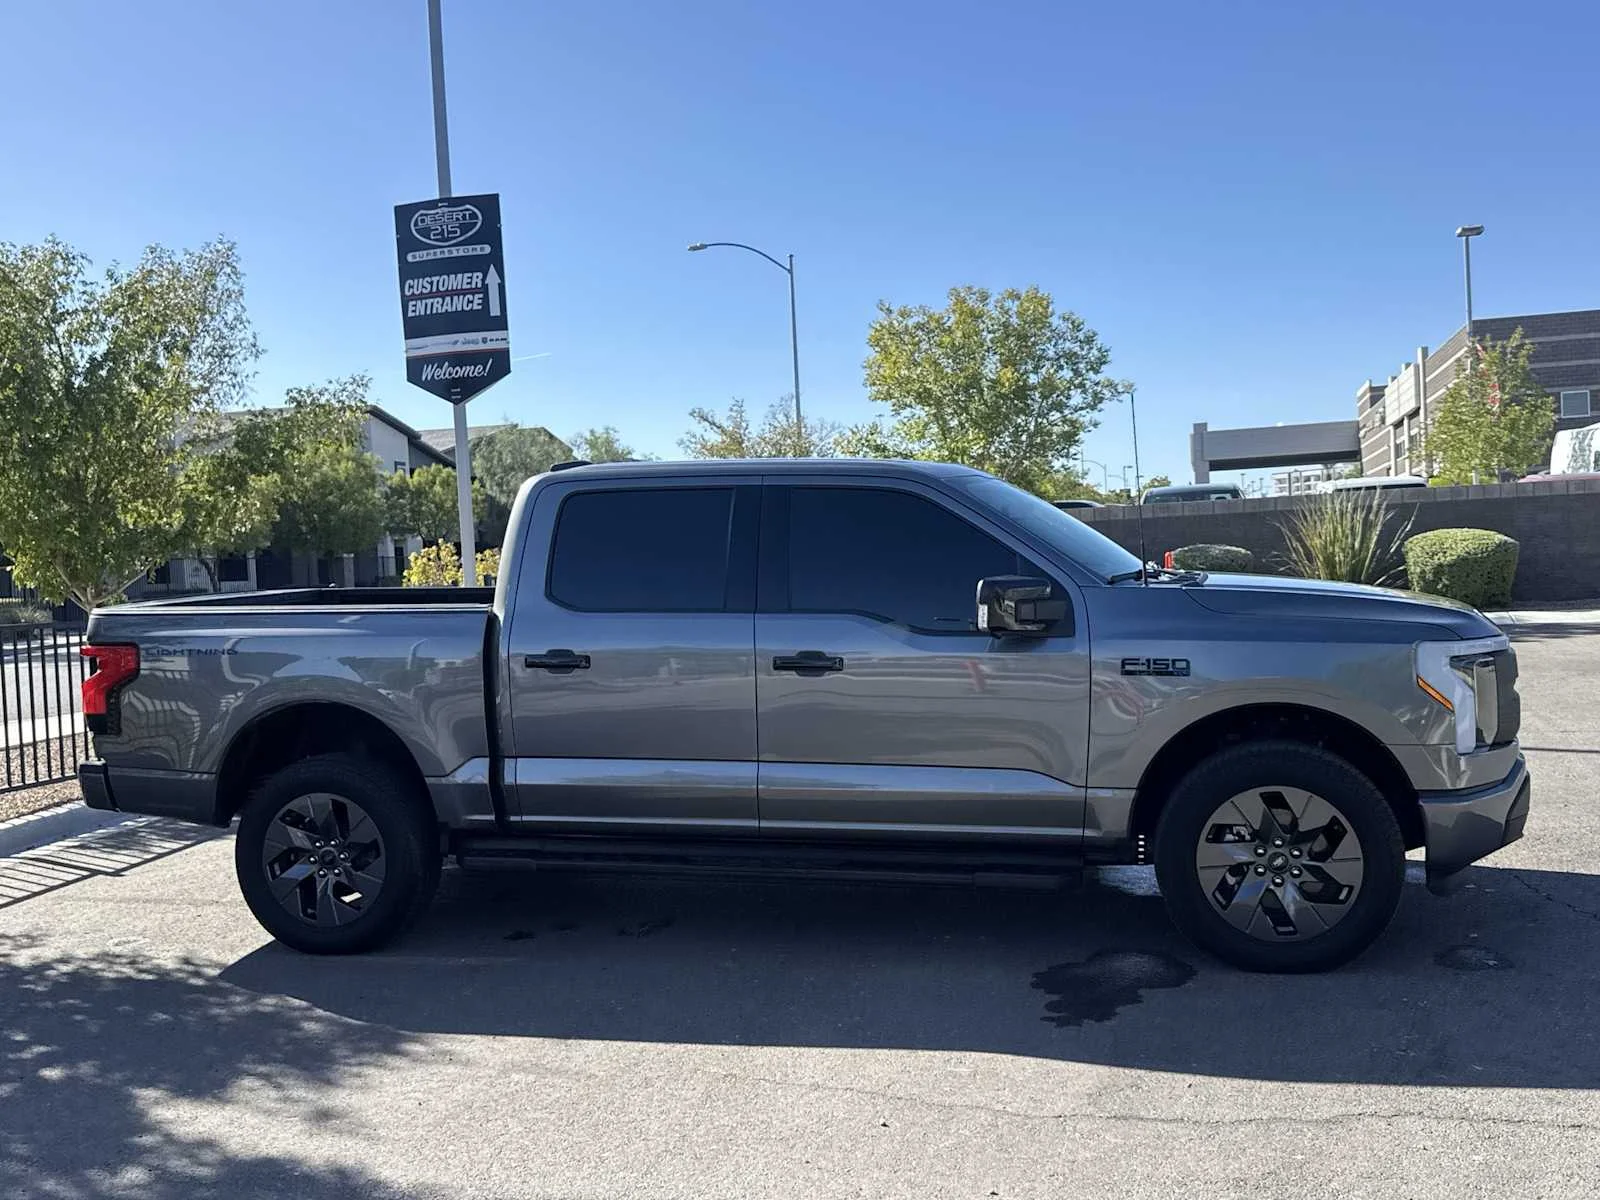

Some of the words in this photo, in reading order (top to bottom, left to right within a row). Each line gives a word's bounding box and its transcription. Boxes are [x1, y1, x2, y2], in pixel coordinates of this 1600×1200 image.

[417, 210, 472, 226] DESERT
[430, 224, 461, 239] 215
[411, 246, 486, 259] SUPERSTORE
[404, 272, 483, 296] CUSTOMER
[407, 294, 484, 317] ENTRANCE
[422, 358, 493, 381] Welcome!
[144, 648, 238, 656] LIGHTNING
[1120, 658, 1190, 676] F-150
